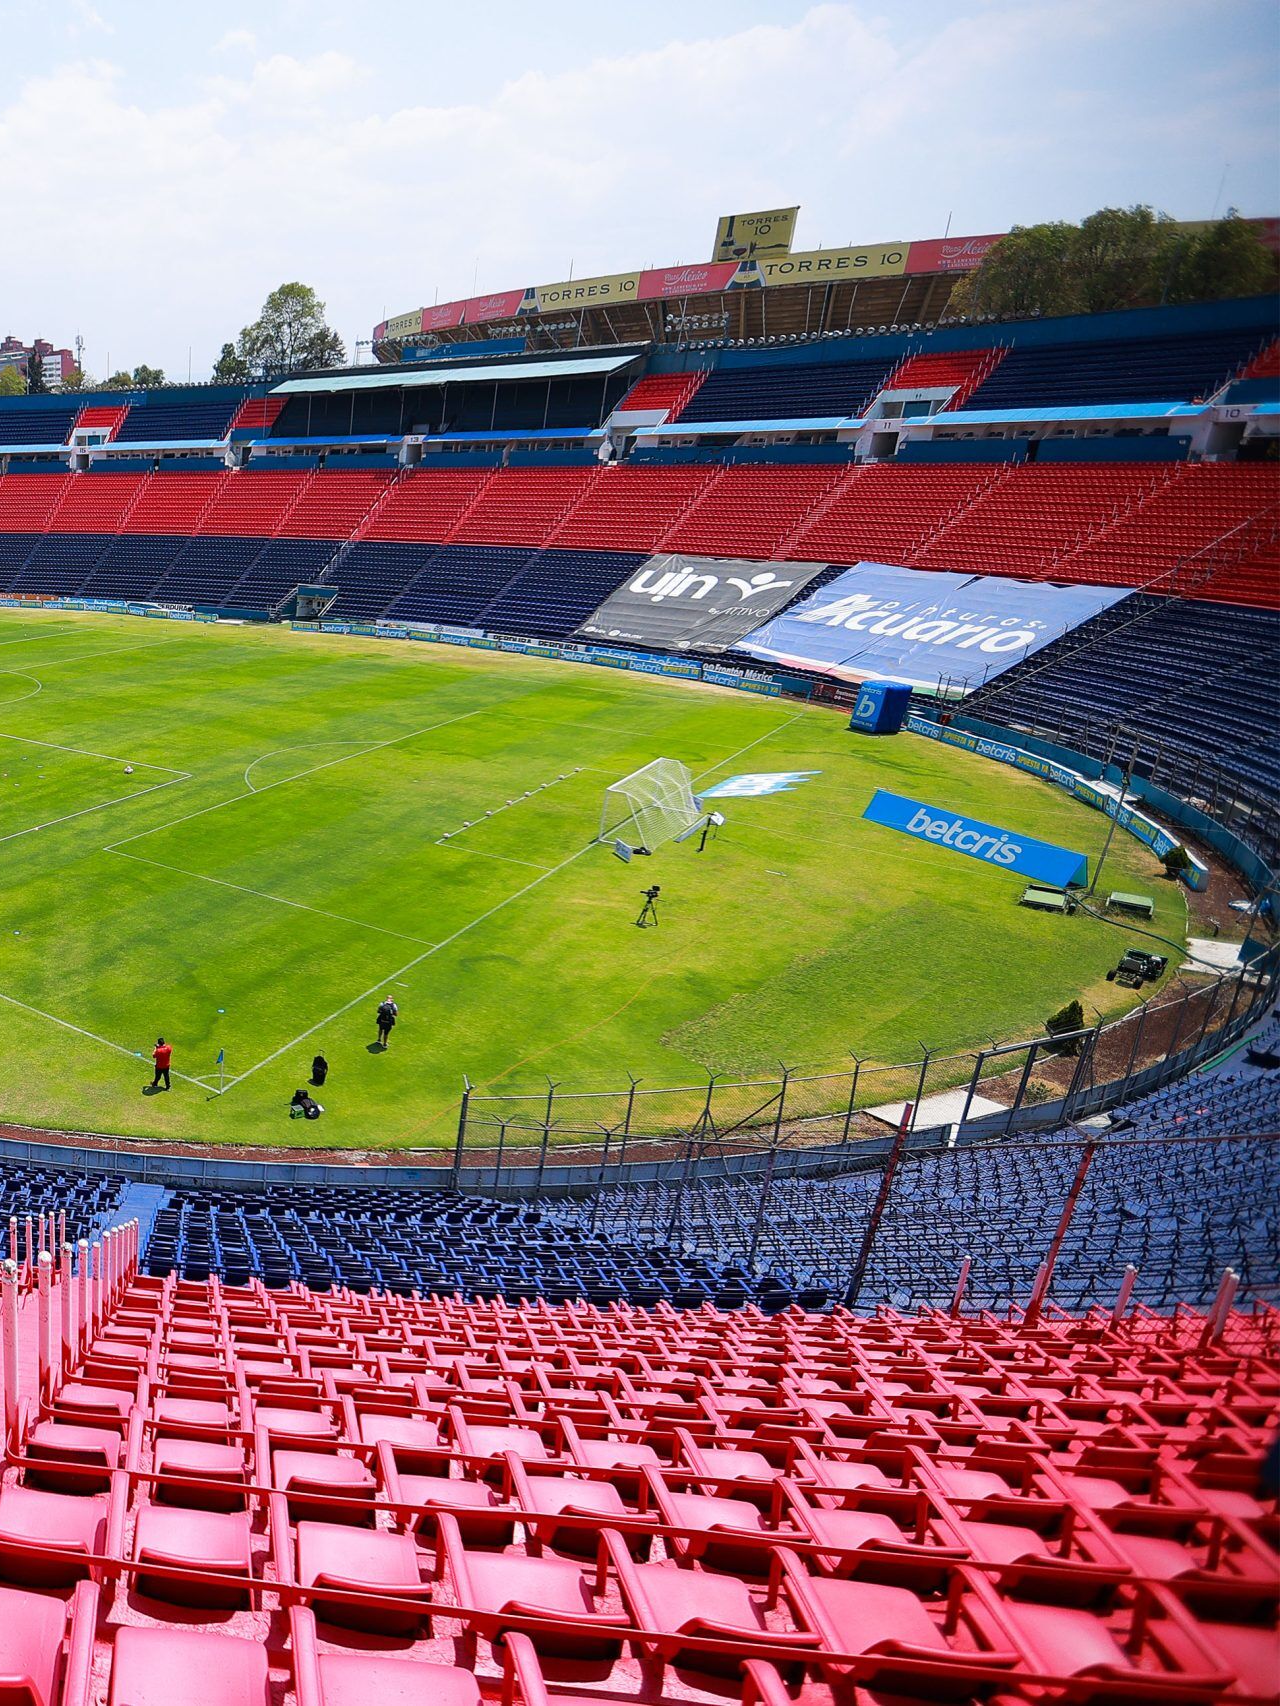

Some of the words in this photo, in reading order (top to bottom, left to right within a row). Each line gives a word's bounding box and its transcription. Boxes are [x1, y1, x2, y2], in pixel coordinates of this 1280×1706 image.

[740, 214, 789, 226] TORRES
[753, 224, 771, 236] 10
[764, 255, 868, 276] TORRES
[879, 252, 902, 266] 10
[540, 284, 610, 303] TORRES
[619, 280, 635, 292] 10
[388, 318, 413, 333] TORRES
[1226, 409, 1240, 418] 10
[169, 611, 193, 620] betcris
[716, 606, 770, 618] ATTIVO
[877, 601, 1042, 629] pinturas
[320, 624, 350, 633] betcris
[795, 593, 1037, 653] Acuario
[375, 629, 406, 638] betcris
[439, 634, 469, 645] betcris
[560, 650, 592, 663] betcris
[662, 665, 689, 675] APUESTA
[715, 663, 744, 677] Frontón
[744, 669, 773, 682] México
[702, 671, 737, 687] betcris
[740, 681, 769, 692] APUESTA
[769, 684, 779, 693] YA
[856, 694, 875, 718] b
[908, 717, 939, 739] betcris
[943, 731, 967, 746] APUESTA
[967, 737, 975, 748] YA
[976, 740, 1016, 762] betcris
[1017, 755, 1041, 771] APUESTA
[1041, 764, 1049, 773] YA
[1074, 784, 1096, 801] APUESTA
[905, 807, 1023, 865] betcris
